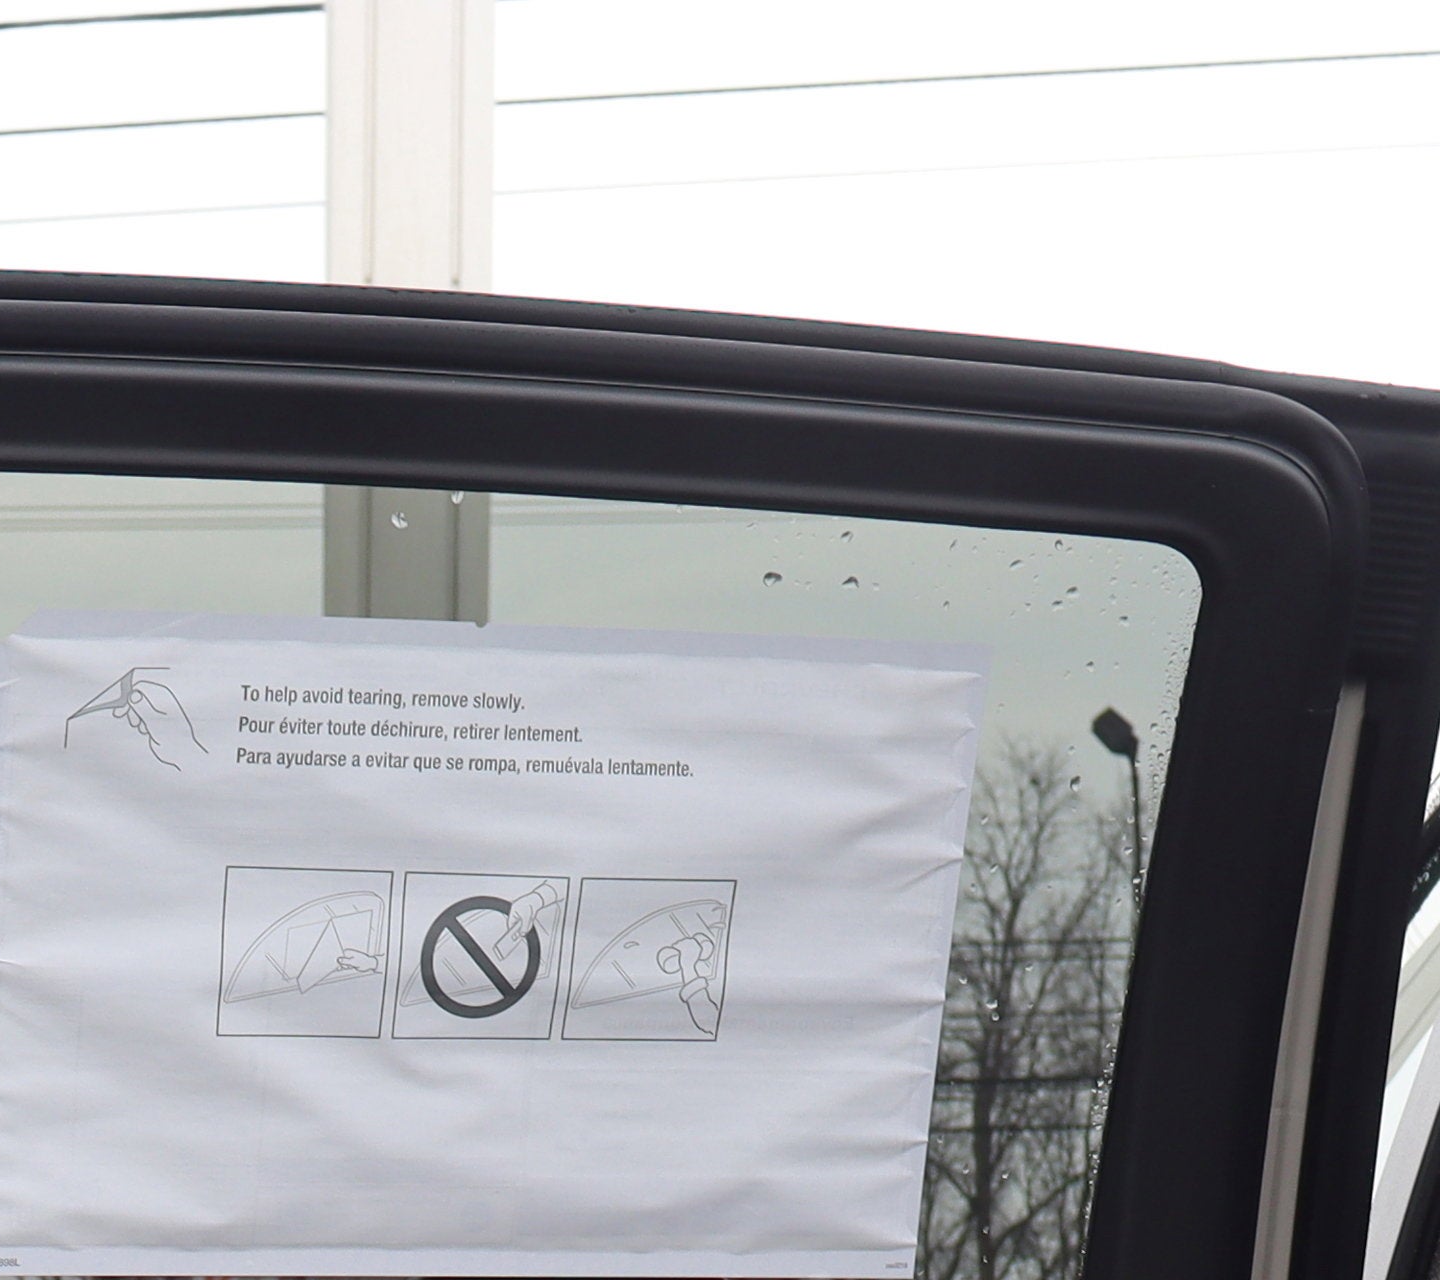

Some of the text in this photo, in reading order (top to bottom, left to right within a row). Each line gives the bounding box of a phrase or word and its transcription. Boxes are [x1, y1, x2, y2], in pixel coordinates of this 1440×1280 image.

[241, 684, 525, 713] To help avoid tearing, remove slowly.
[238, 716, 583, 743] Pour éviter toute déchirure, retirer lentement.
[236, 747, 694, 777] Para ayudarse a evitar que se rompa, remuévala lentamente.
